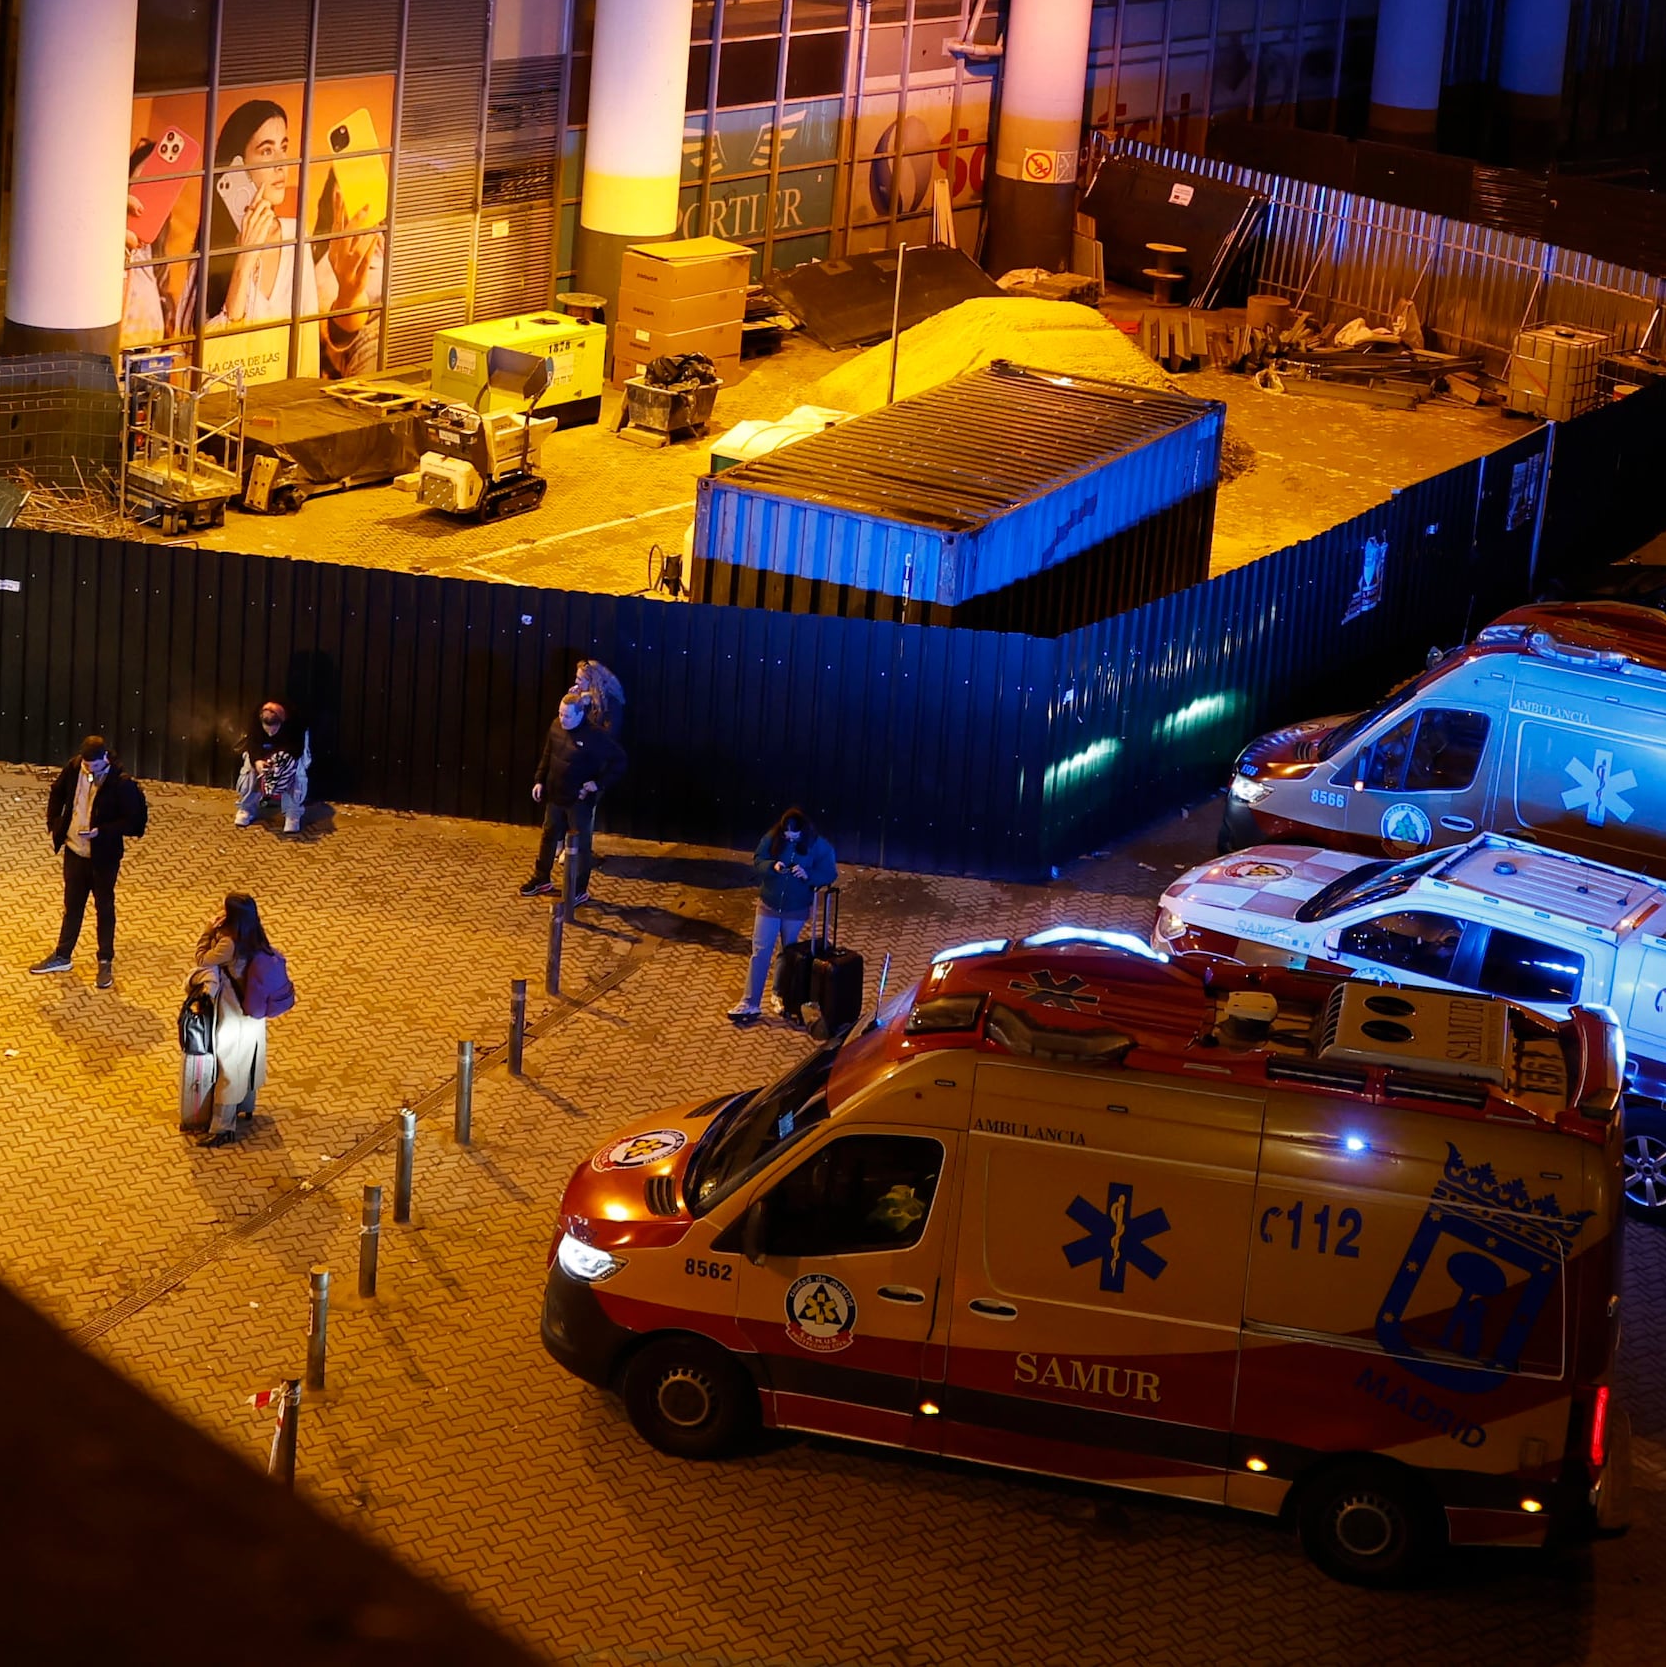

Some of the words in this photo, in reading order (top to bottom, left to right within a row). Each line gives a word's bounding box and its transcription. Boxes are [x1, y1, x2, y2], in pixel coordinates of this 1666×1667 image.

[207, 362, 220, 373] LA
[247, 355, 261, 367] DE
[262, 352, 280, 364] LAS
[1513, 698, 1591, 725] AMBULANCIA
[1310, 789, 1346, 808] 8566
[1445, 1000, 1484, 1063] SAMUR
[974, 1118, 1086, 1146] AMBULANCIA
[685, 1258, 733, 1281] 8562
[1014, 1352, 1162, 1403] SAMUR
[1355, 1365, 1487, 1448] MADRID
